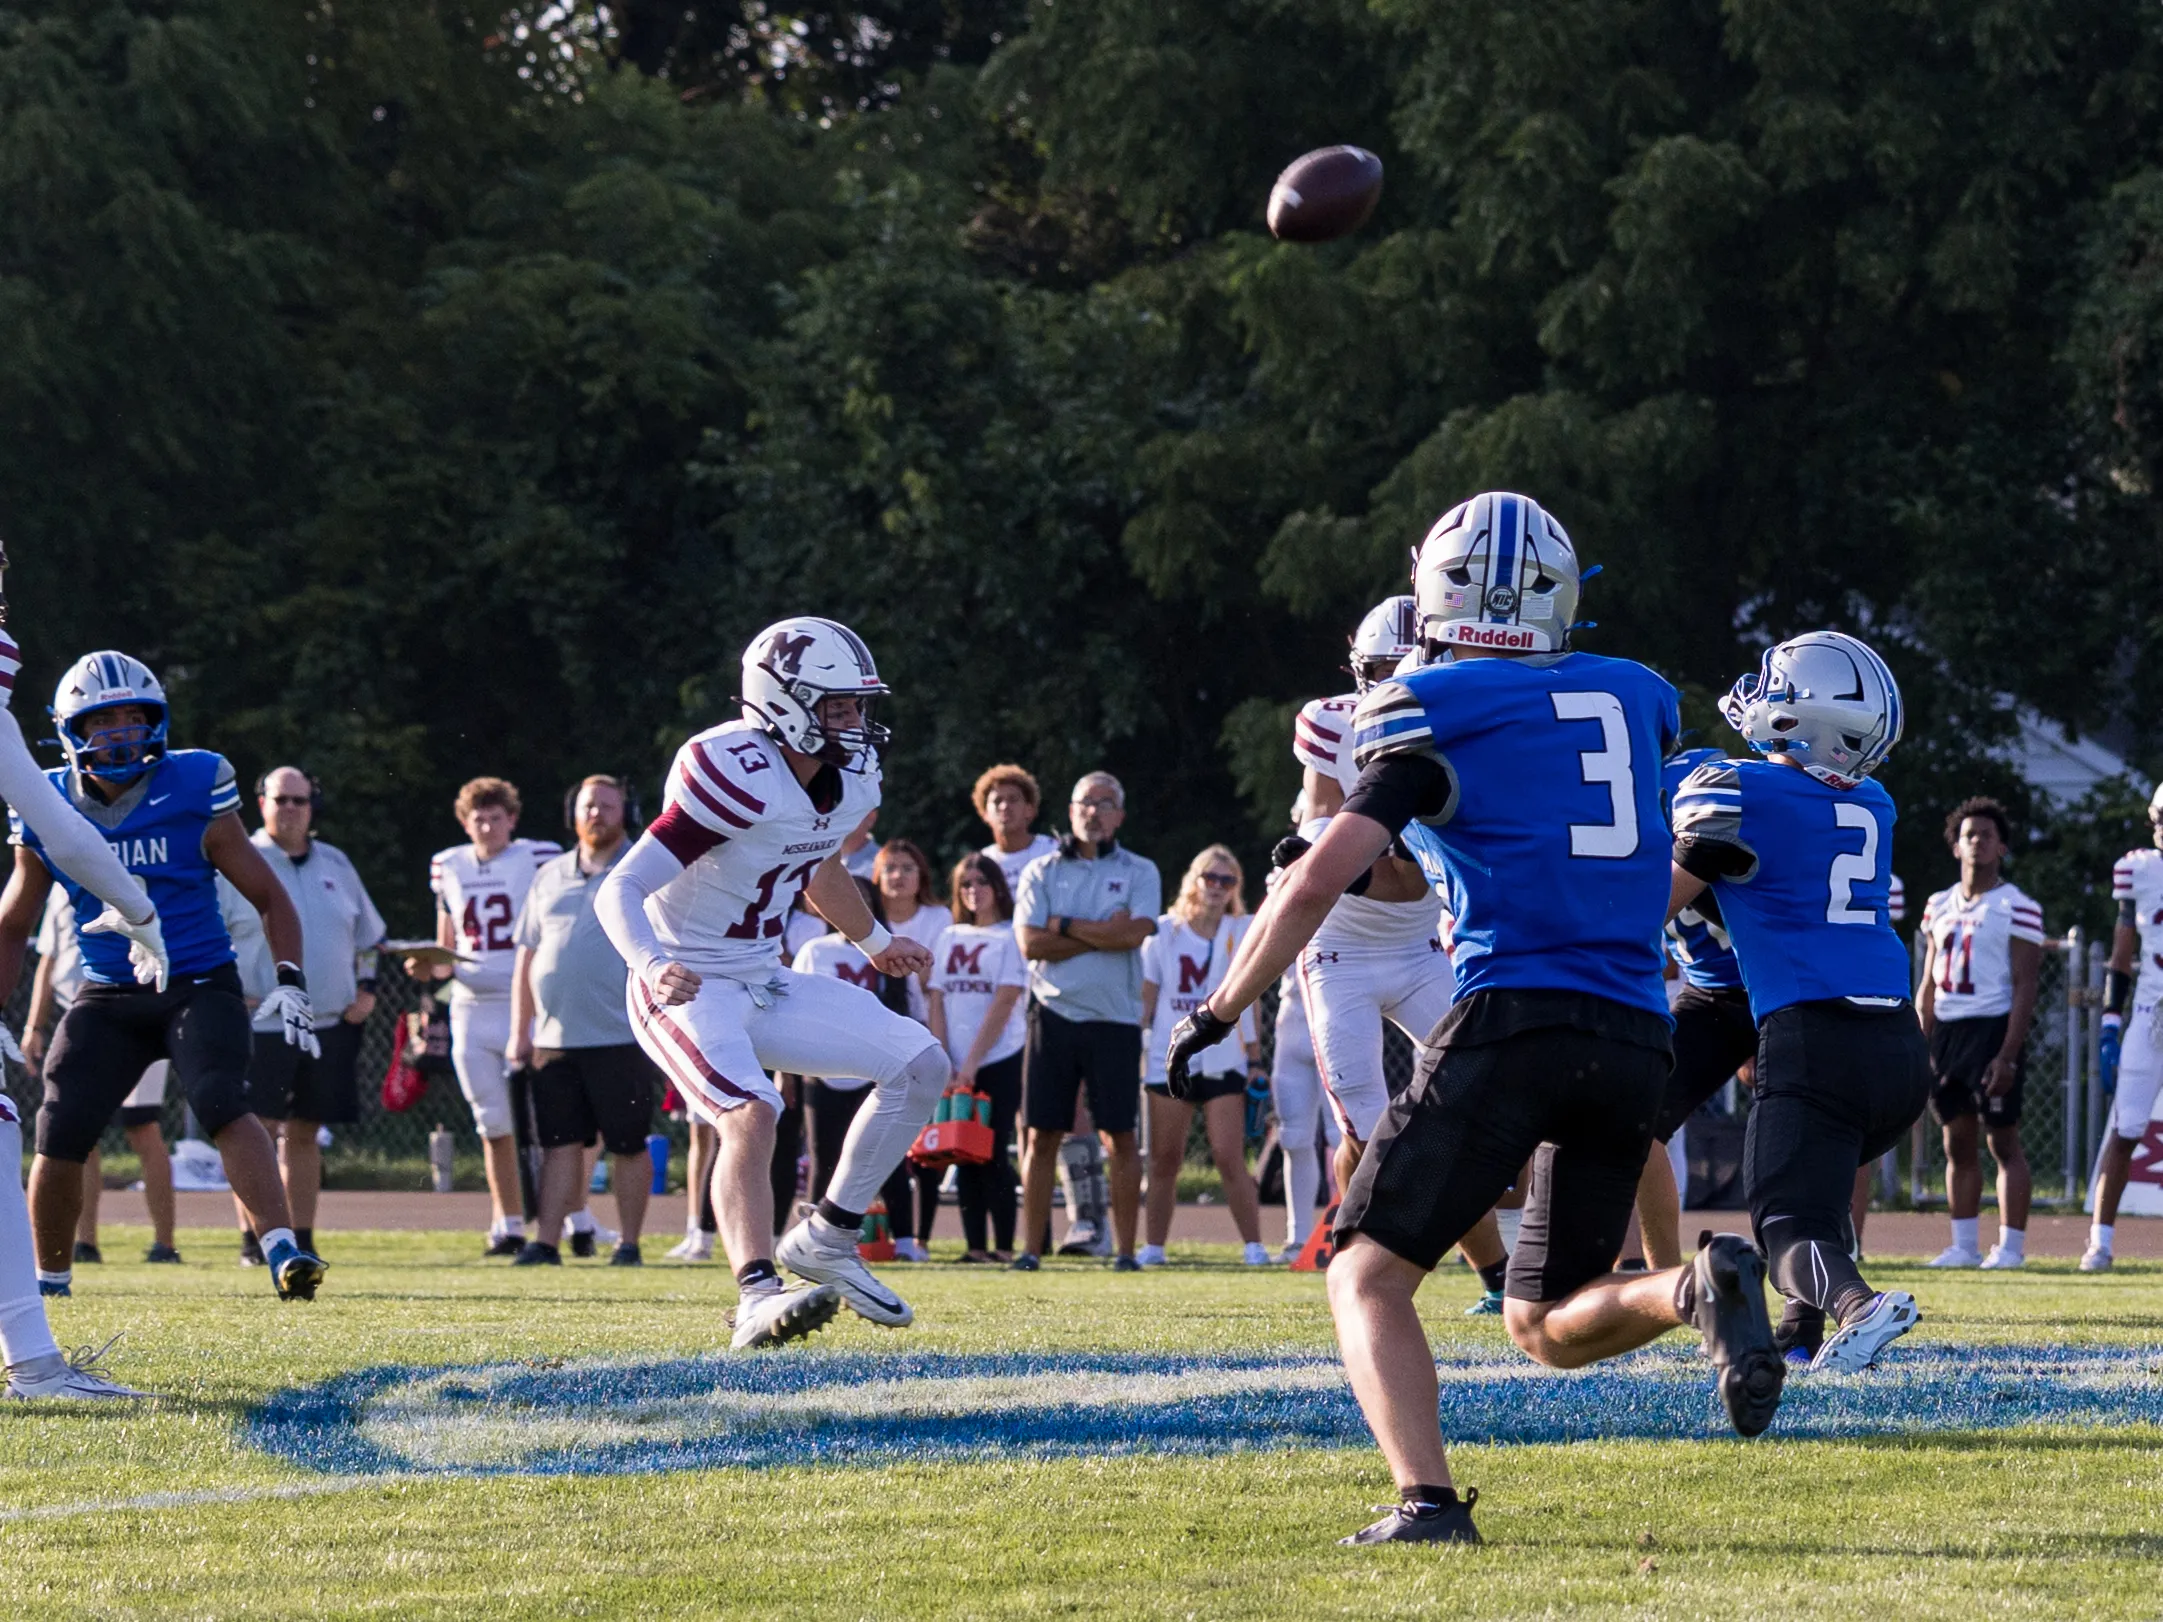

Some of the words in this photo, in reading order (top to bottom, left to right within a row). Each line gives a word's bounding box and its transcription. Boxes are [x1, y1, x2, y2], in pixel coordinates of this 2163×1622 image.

[763, 631, 817, 676] M
[1458, 625, 1534, 649] Riddell
[725, 741, 770, 774] 13
[1549, 691, 1639, 858] 3
[1827, 802, 1879, 925] 2
[463, 893, 514, 952] 42
[945, 942, 989, 974] M
[1178, 954, 1213, 993] M
[1942, 931, 1976, 995] 11
[924, 1128, 939, 1151] G
